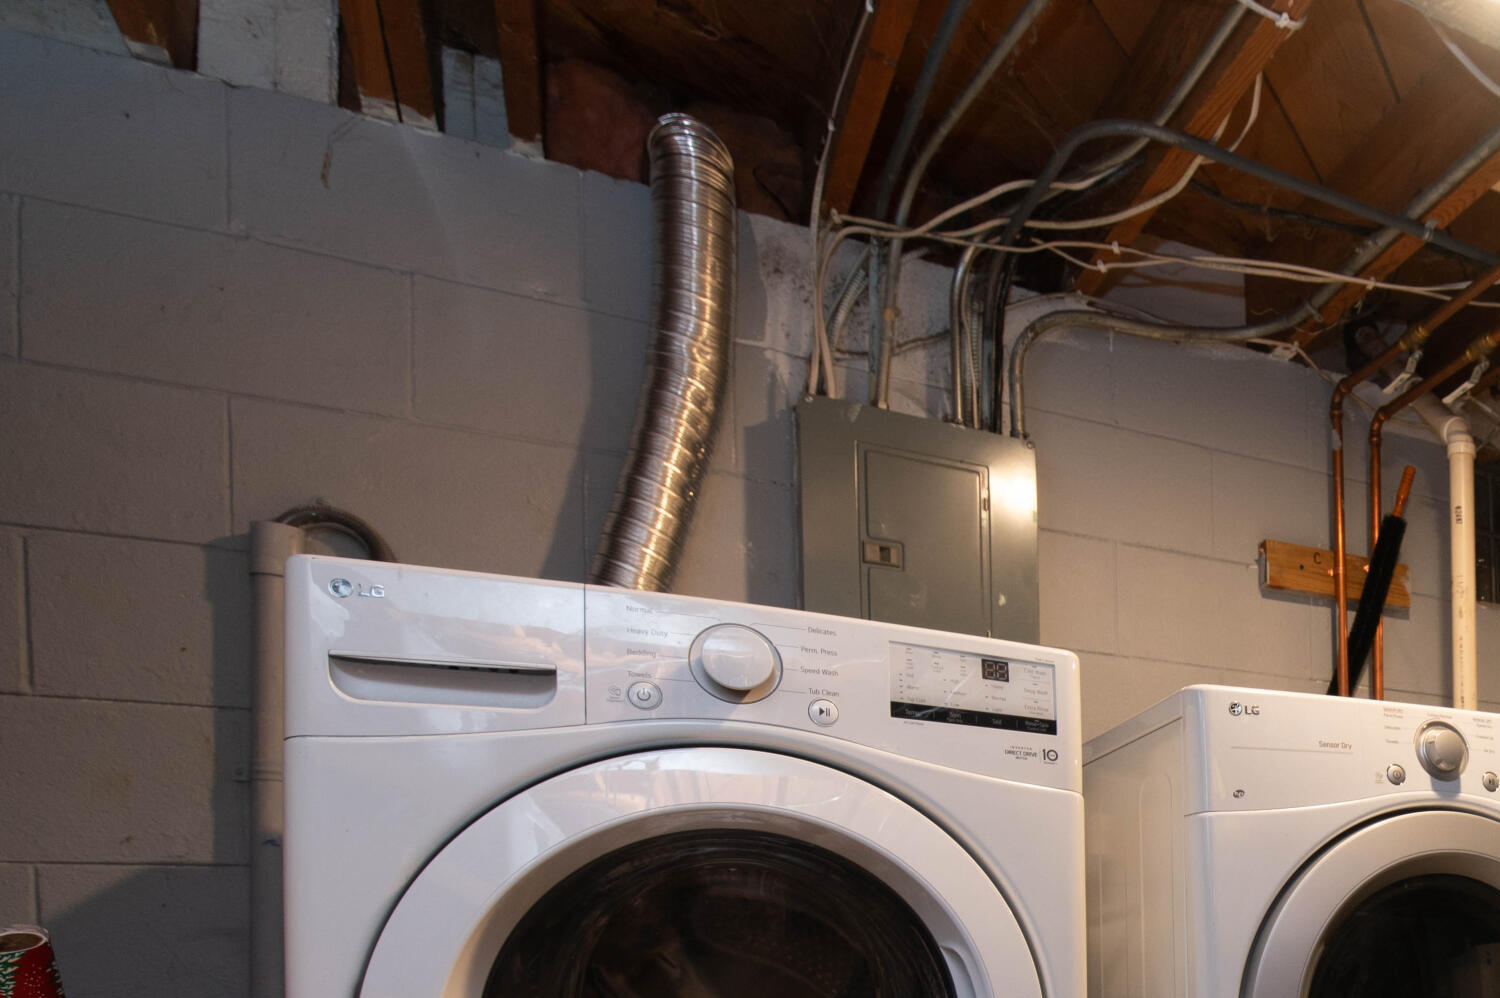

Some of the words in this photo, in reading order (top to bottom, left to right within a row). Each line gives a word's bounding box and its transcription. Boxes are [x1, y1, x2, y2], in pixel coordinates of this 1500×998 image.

[358, 583, 385, 598] LG
[626, 627, 649, 636] Heavy
[651, 628, 668, 638] Duty
[808, 626, 837, 636] Delicates
[627, 648, 656, 659] Bedding
[820, 647, 838, 656] Press
[627, 670, 652, 679] Towels
[800, 666, 820, 675] Speed
[822, 668, 839, 677] Wash
[808, 687, 820, 696] Tub
[821, 688, 840, 697] Clean
[1244, 705, 1260, 716] LG
[1319, 740, 1340, 749] Sensor
[1341, 741, 1352, 750] Dry
[1023, 750, 1038, 758] DRIVE
[1043, 748, 1059, 762] 10
